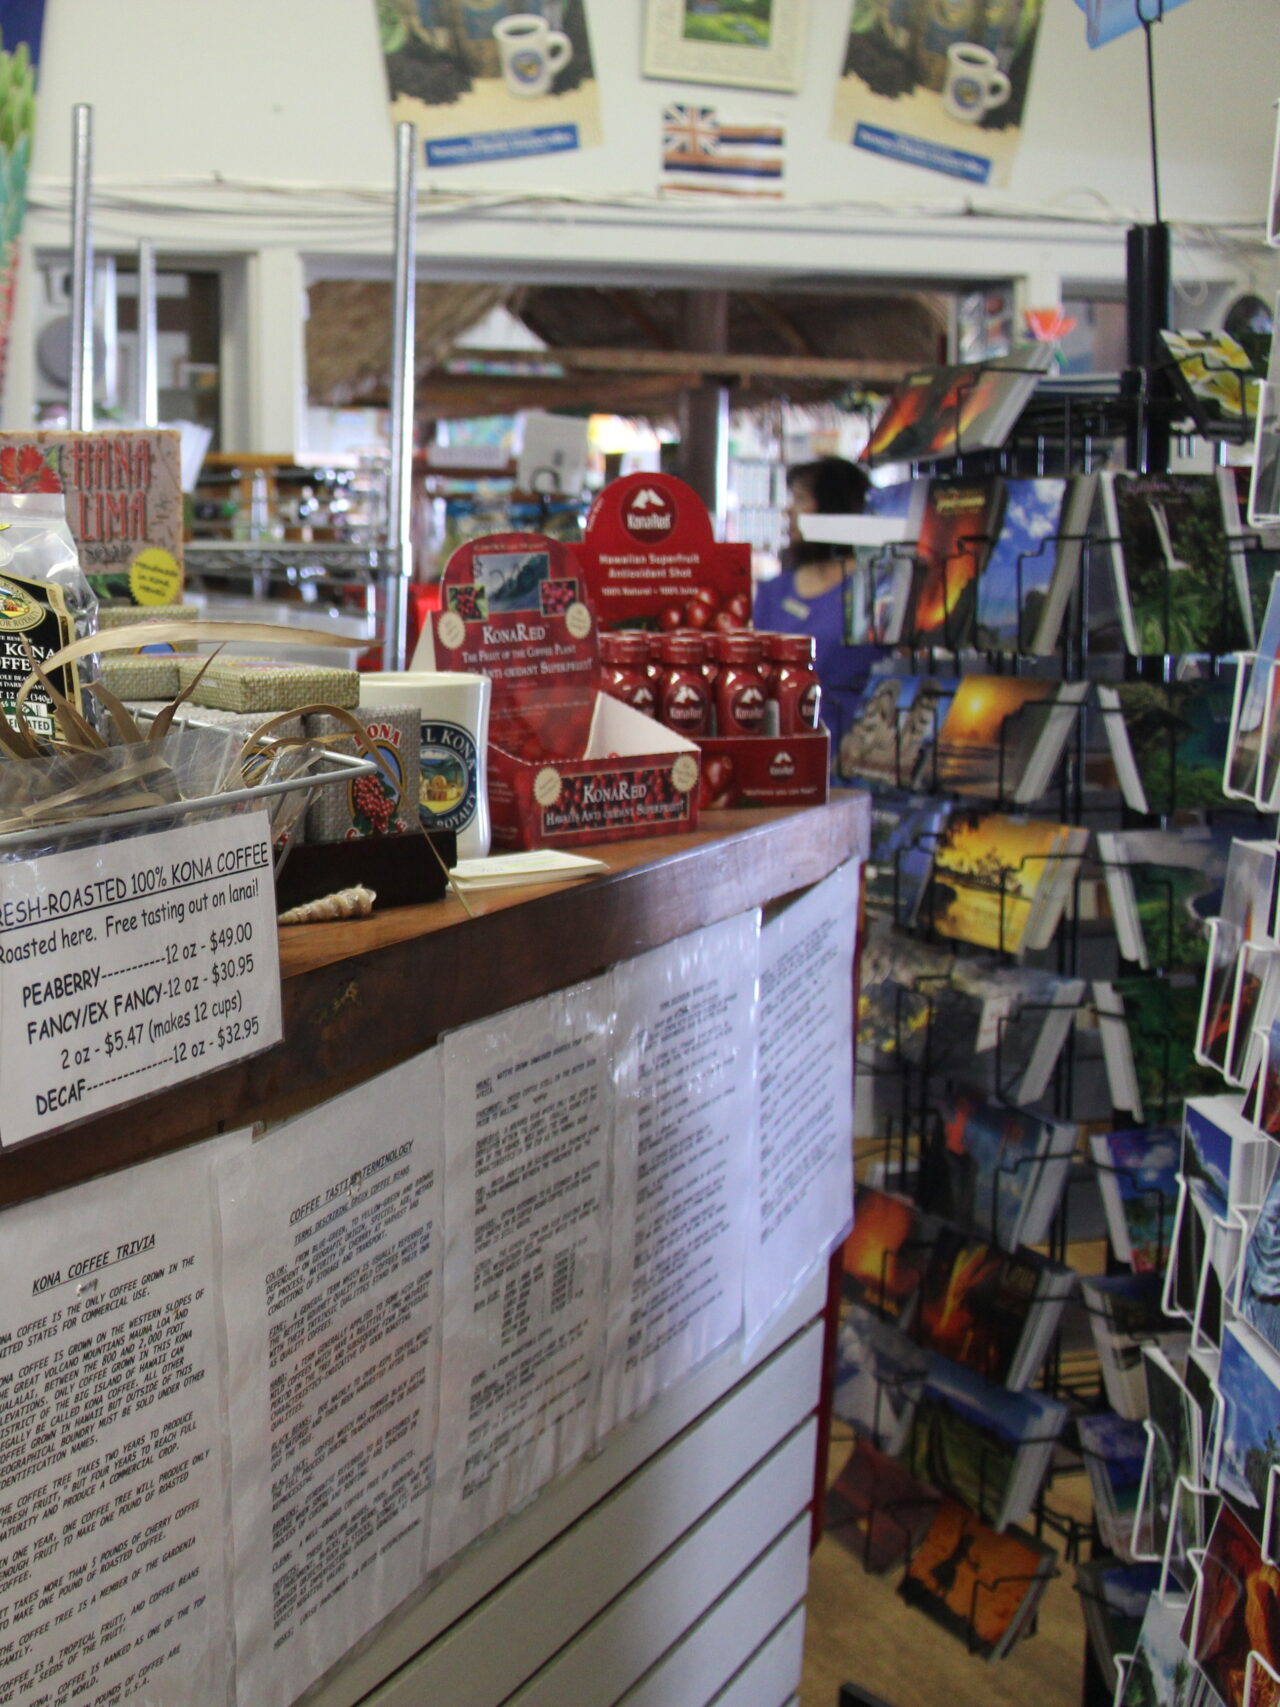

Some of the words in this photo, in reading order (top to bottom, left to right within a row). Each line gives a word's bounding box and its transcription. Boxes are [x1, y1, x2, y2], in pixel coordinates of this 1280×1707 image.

[72, 439, 150, 488] HANA
[79, 492, 146, 540] LIMA
[132, 866, 166, 895] 100%
[171, 856, 212, 885] KONA
[217, 843, 267, 874] COFFEE
[61, 927, 96, 948] here.
[106, 915, 137, 936] Free
[141, 904, 184, 927] tasting
[189, 895, 207, 914] out
[212, 894, 225, 908] on
[229, 879, 258, 902] lanai!
[182, 943, 196, 959] oz
[210, 922, 252, 952] $49.00
[28, 1001, 108, 1044] FANCY/EX
[184, 976, 198, 992] oz
[212, 955, 253, 987] $30.95
[61, 1049, 69, 1069] 2
[75, 1048, 89, 1061] oz
[105, 1025, 143, 1058] $5.47
[148, 1013, 190, 1044] (makes
[194, 1003, 207, 1022] 12
[212, 991, 242, 1017] cups)
[191, 1041, 205, 1057] oz
[218, 1017, 259, 1051] $32.95
[289, 1196, 320, 1224] COFFEE
[363, 1140, 413, 1178] TERMINOLOGY
[17, 1318, 46, 1338] COFFEE
[52, 1312, 61, 1323] IS
[67, 1304, 80, 1317] THE
[85, 1294, 105, 1309] ONLY
[109, 1281, 136, 1299] COFFEE
[141, 1269, 164, 1285] GROWN
[168, 1263, 177, 1274] IN
[182, 1256, 194, 1268] THE
[32, 1272, 60, 1294] KONA
[68, 1252, 109, 1280] COFFEE
[116, 1234, 155, 1260] TRIVIA
[13, 1376, 38, 1394] GREAT
[44, 1358, 78, 1380] VOLCANO
[157, 1317, 169, 1329] LOA
[174, 1309, 187, 1322] AND
[18, 1358, 48, 1378] COFFEE
[54, 1351, 63, 1363] IS
[68, 1339, 91, 1357] GROWN
[97, 1333, 105, 1344] ON
[111, 1324, 124, 1338] THE
[129, 1308, 160, 1330] WESTERN
[165, 1295, 191, 1314] SLOPES
[196, 1290, 204, 1300] OF
[27, 1327, 57, 1347] STATES
[62, 1318, 76, 1332] FOR
[81, 1297, 127, 1324] COMMERCIAL
[132, 1287, 149, 1302] USE.
[44, 1370, 78, 1393] BETWEEN
[84, 1361, 97, 1375] THE
[101, 1353, 116, 1367] 800
[120, 1345, 134, 1358] AND
[139, 1333, 161, 1350] 2,000
[166, 1323, 184, 1337] FOOT
[54, 1385, 73, 1401] ONLY
[78, 1369, 107, 1390] COFFEE
[112, 1357, 134, 1374] GROWN
[139, 1351, 148, 1362] IN
[153, 1341, 170, 1355] THIS
[175, 1331, 192, 1345] KONA
